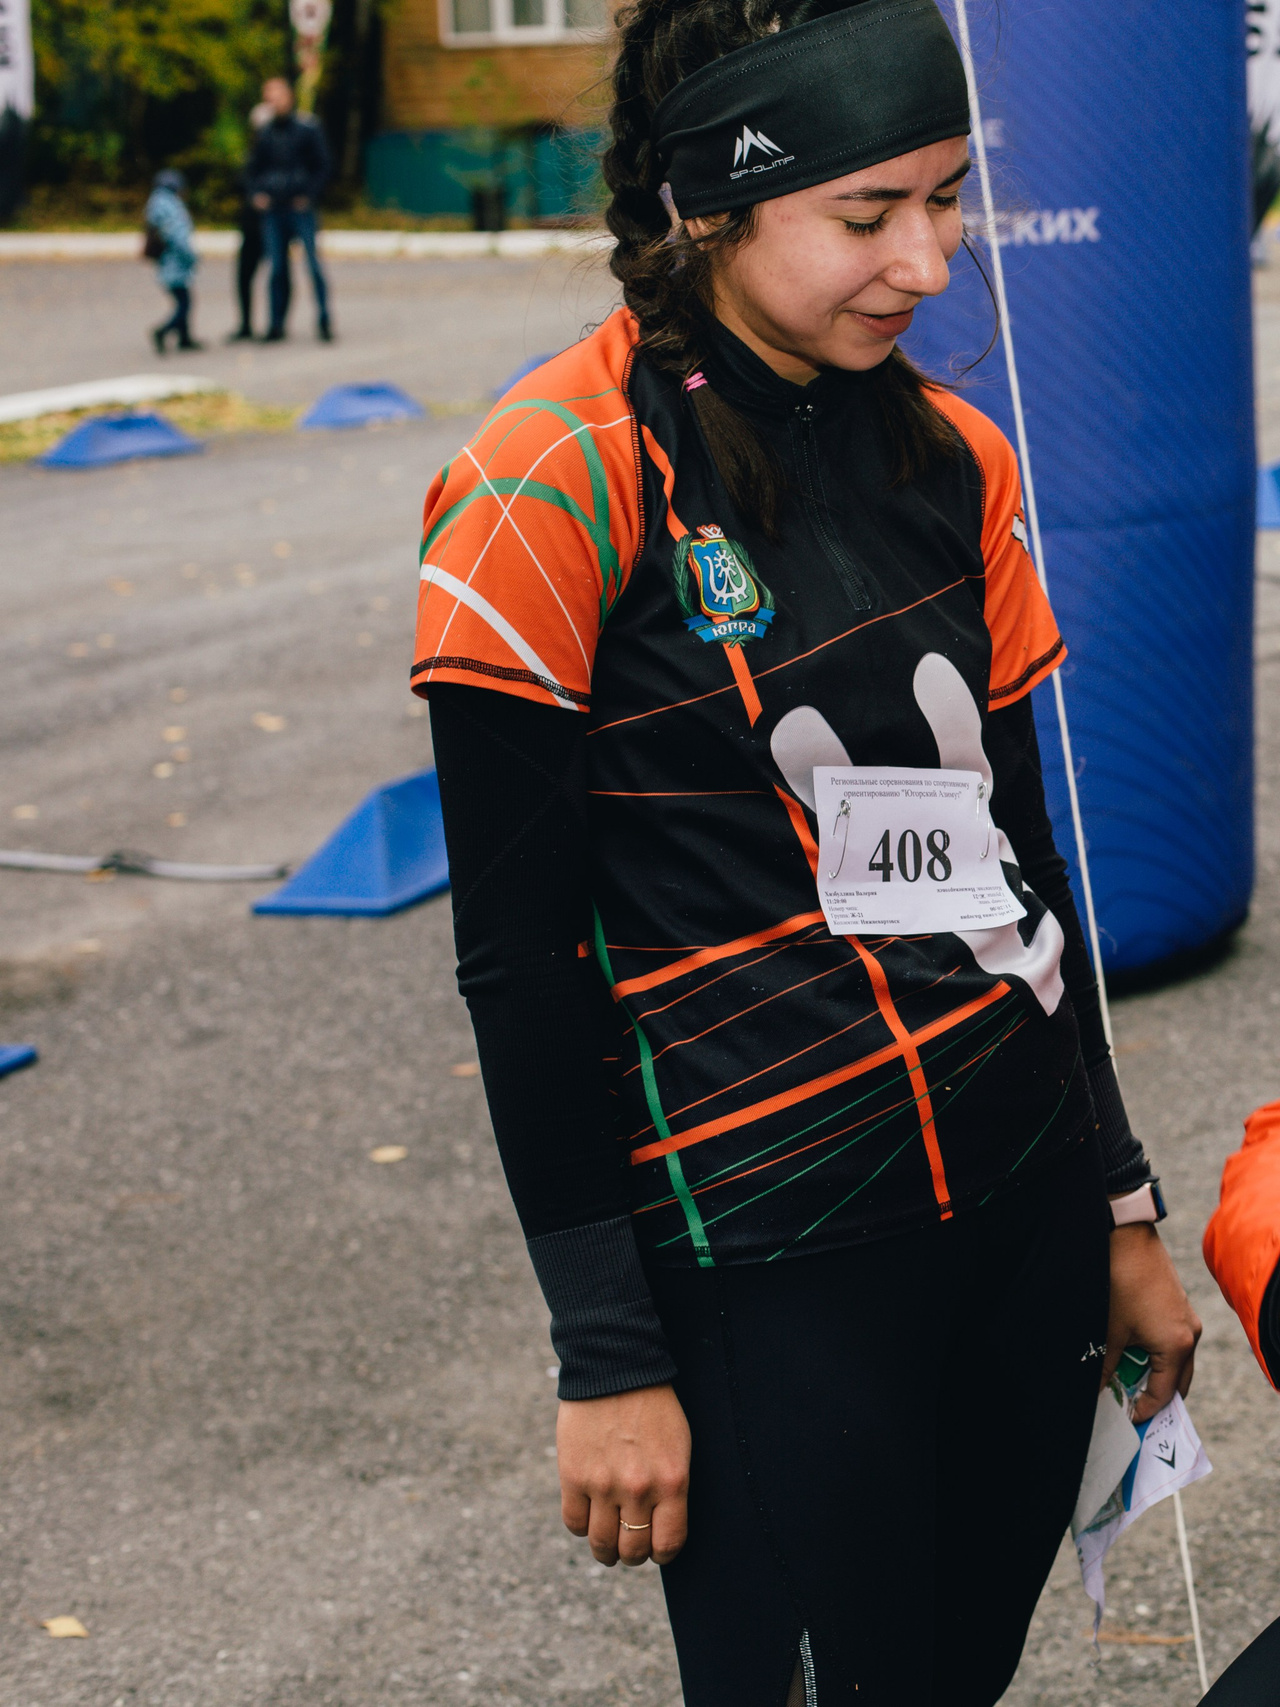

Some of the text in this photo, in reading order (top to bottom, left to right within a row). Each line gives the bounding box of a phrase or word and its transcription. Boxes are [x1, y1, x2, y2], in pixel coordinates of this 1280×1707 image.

[729, 155, 795, 180] SP-OLIMP
[830, 777, 878, 787] Региональные
[879, 779, 923, 788] соревнования
[933, 780, 969, 790] спортивному
[843, 788, 962, 800] ориентированию "Югорский Азимут"
[868, 828, 952, 882] 408
